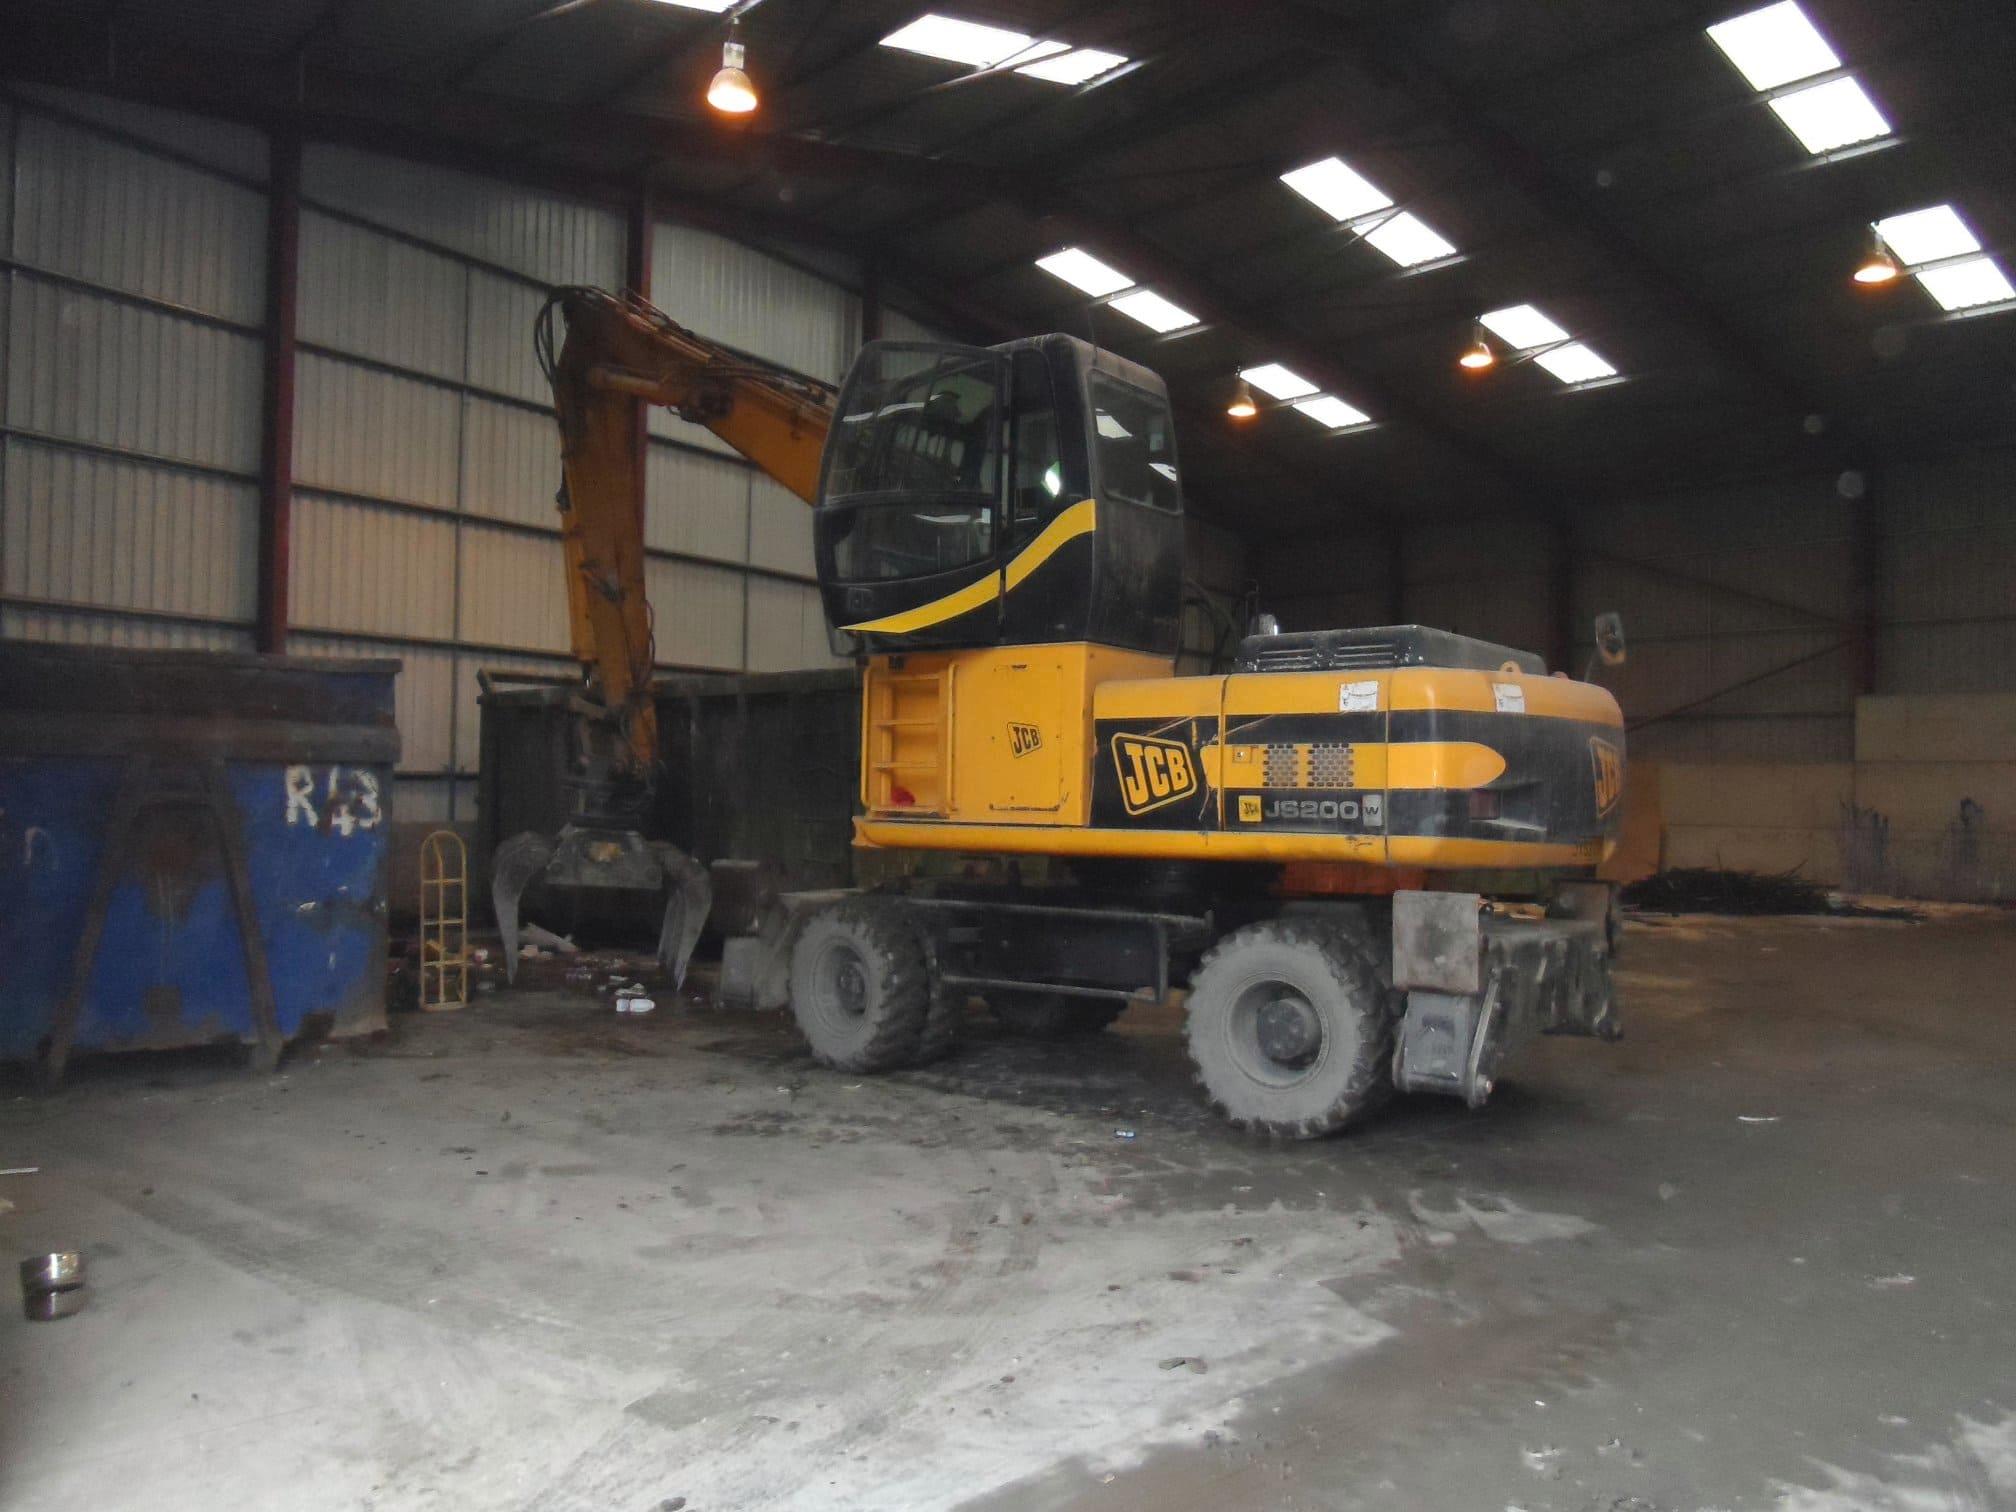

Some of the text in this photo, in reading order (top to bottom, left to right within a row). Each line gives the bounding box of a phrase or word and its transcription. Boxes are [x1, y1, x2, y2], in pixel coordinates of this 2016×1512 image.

[1012, 725, 1040, 754] JCB
[1124, 742, 1189, 806] JCB
[1265, 800, 1359, 819] JS200
[1365, 806, 1379, 815] W
